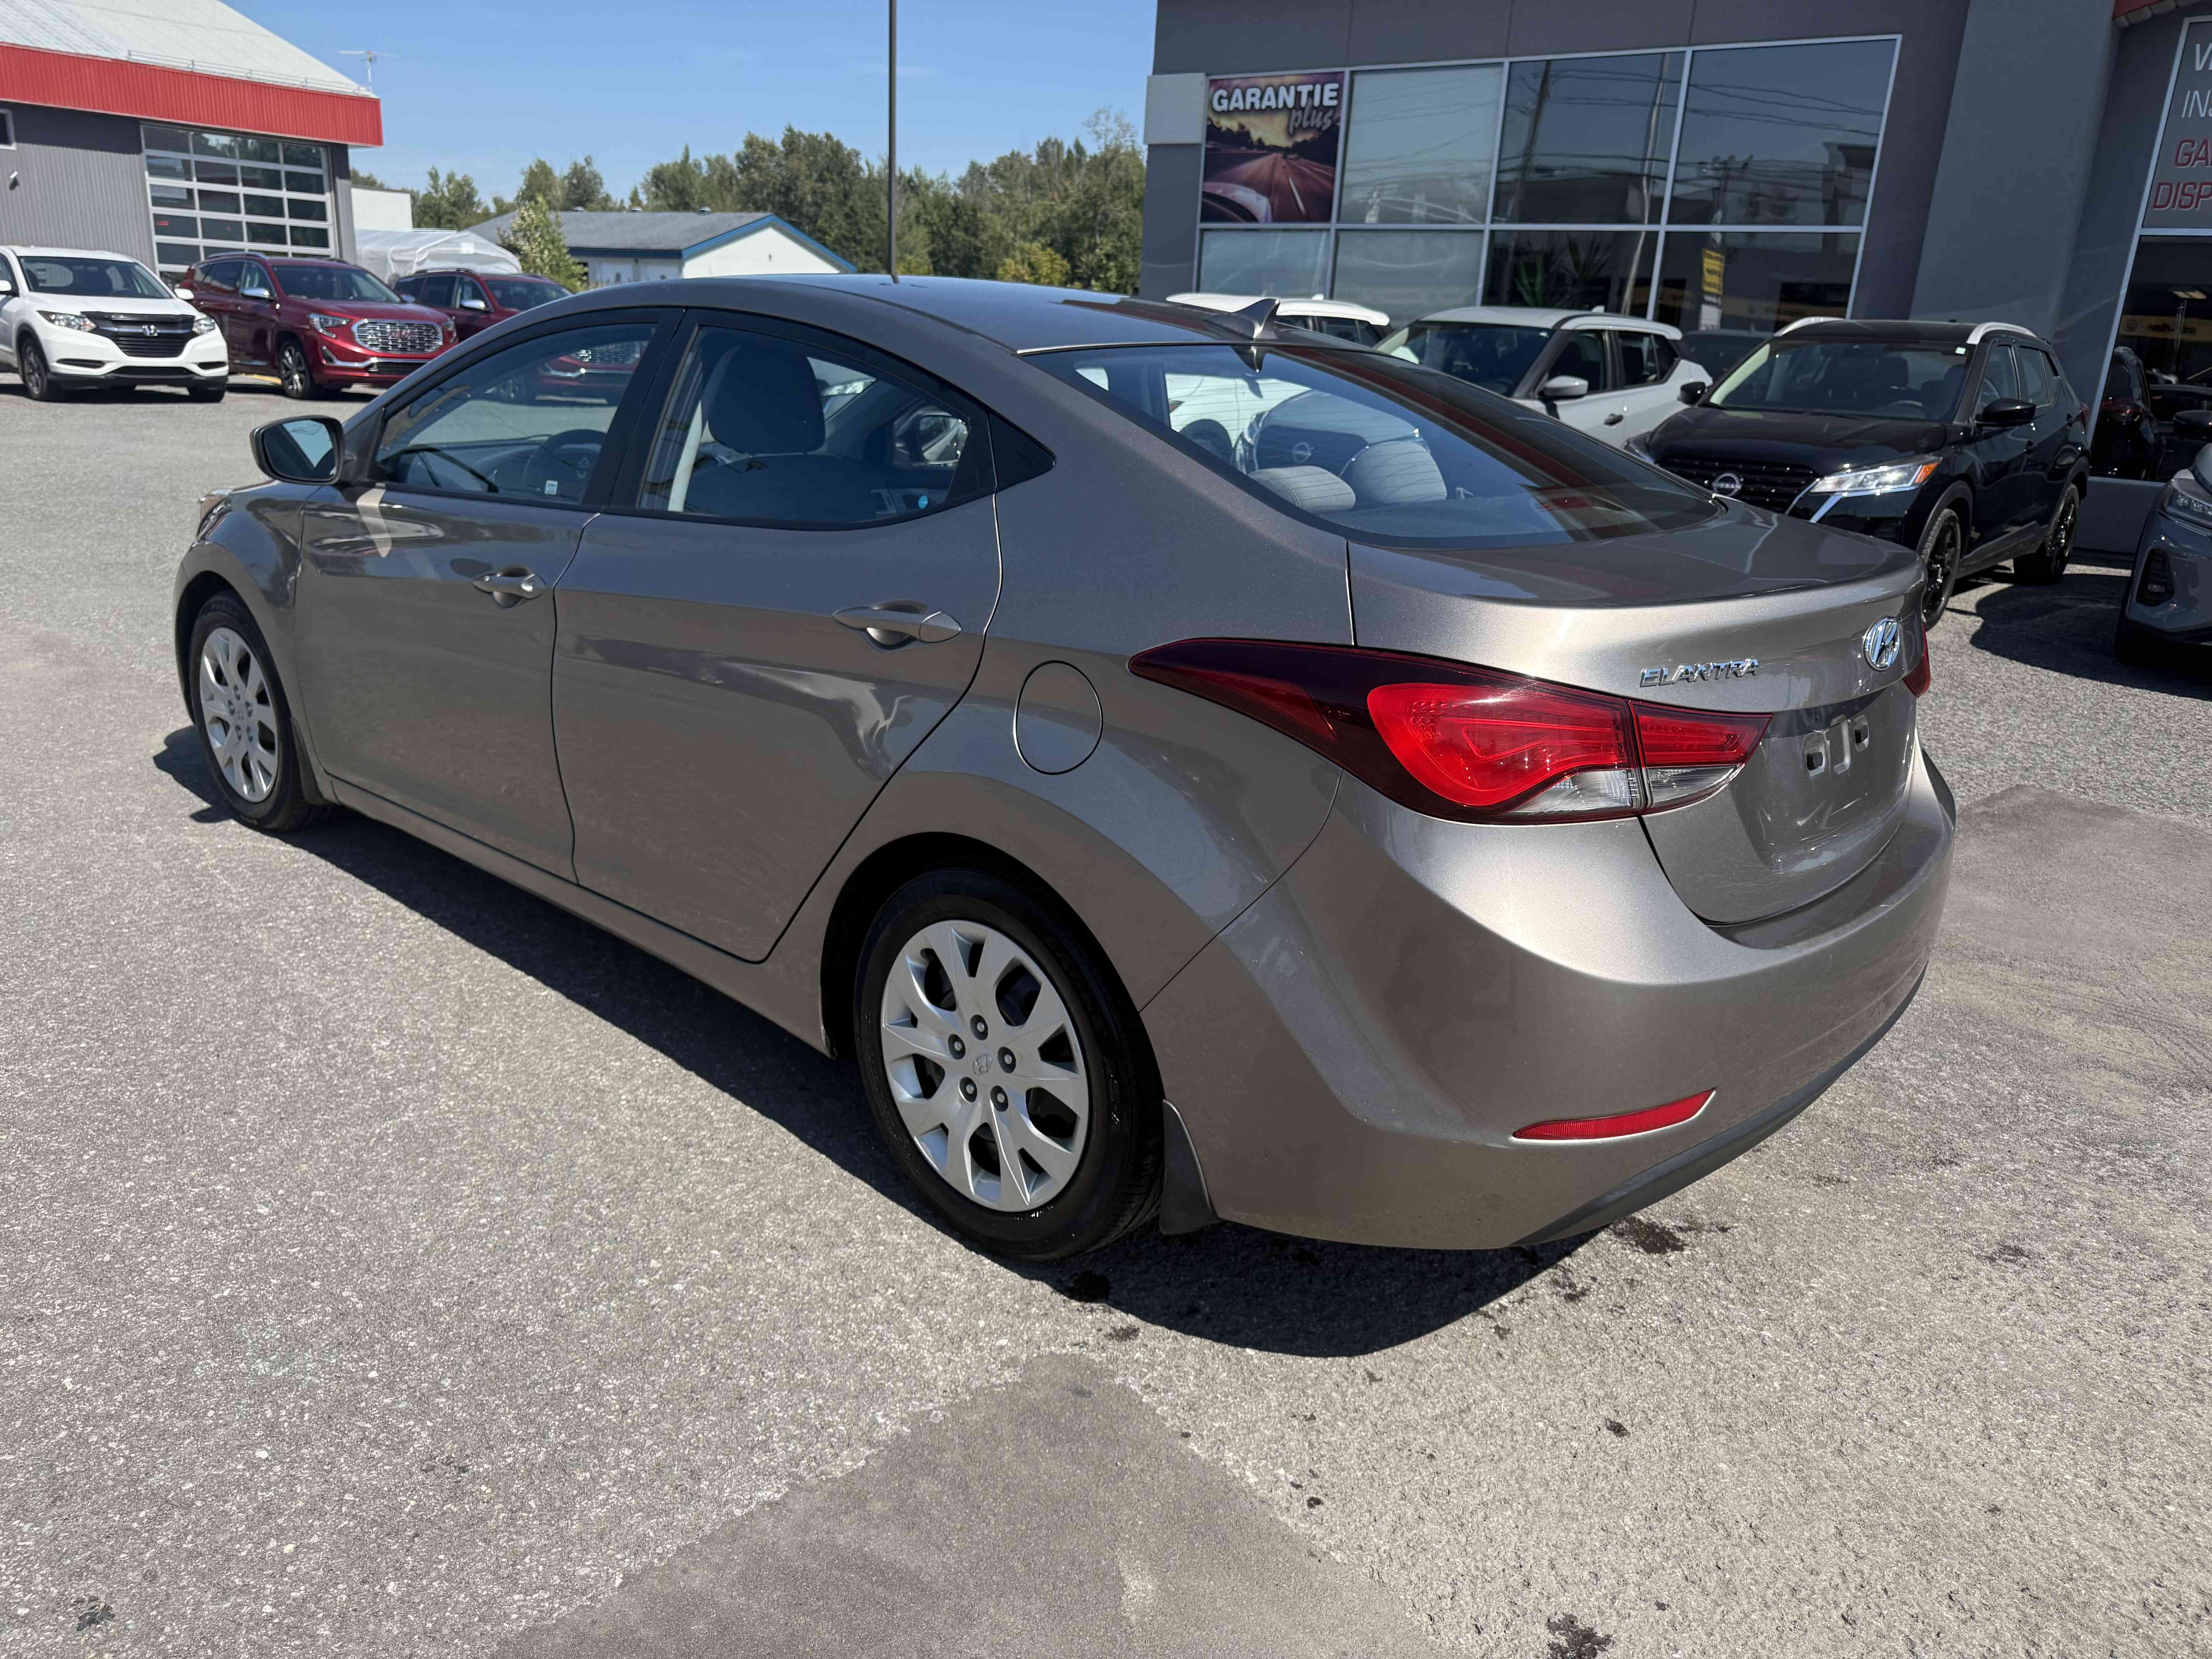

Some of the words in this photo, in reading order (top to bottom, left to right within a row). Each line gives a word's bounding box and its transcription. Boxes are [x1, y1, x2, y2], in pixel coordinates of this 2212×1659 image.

[2195, 43, 2212, 70] V
[1212, 83, 1340, 112] GARANTIE
[2181, 90, 2212, 118] IN
[1289, 97, 1333, 135] plus
[2174, 139, 2212, 168] GA
[2153, 181, 2212, 210] DISP
[1640, 657, 1759, 687] ELANTRA
